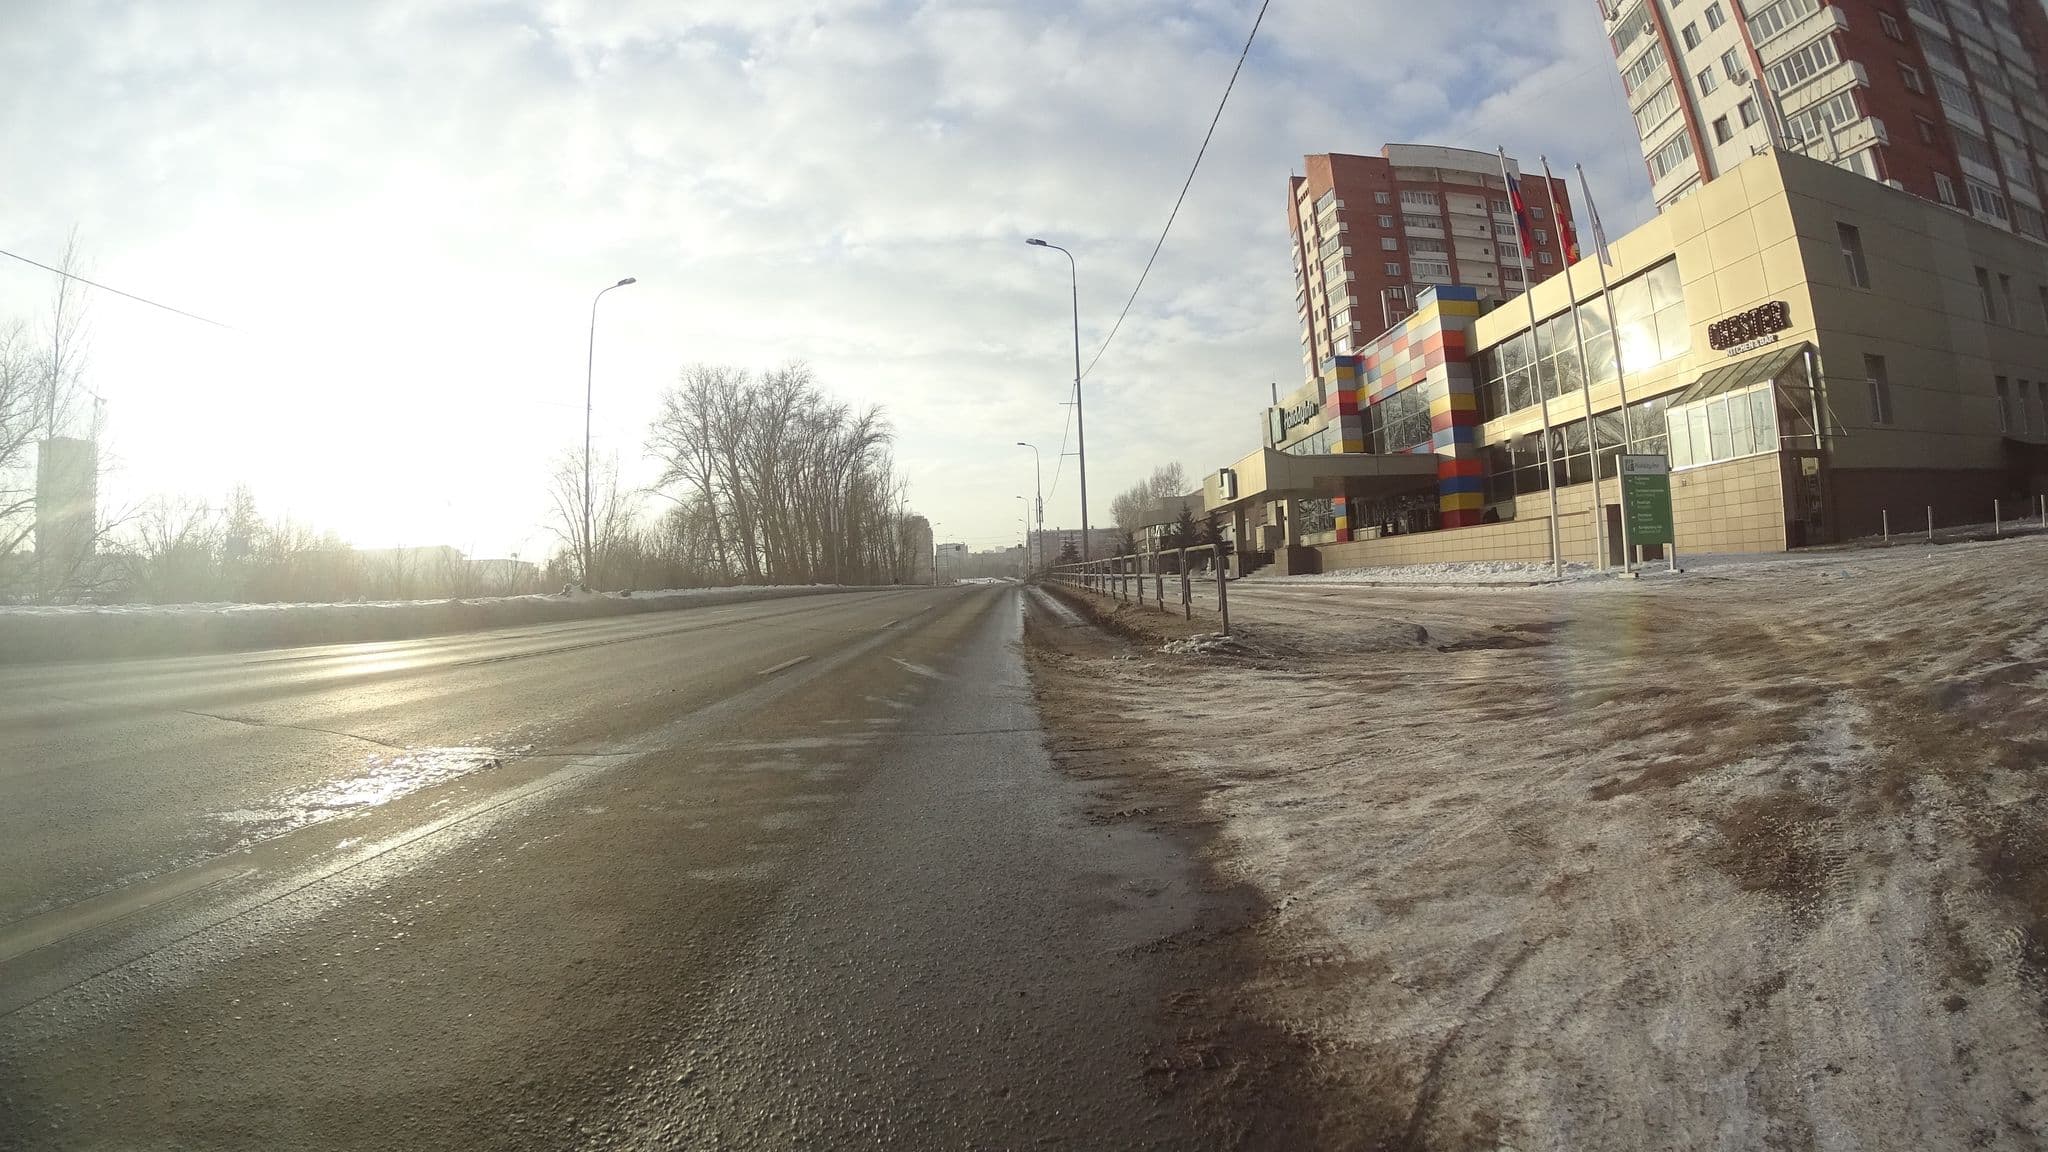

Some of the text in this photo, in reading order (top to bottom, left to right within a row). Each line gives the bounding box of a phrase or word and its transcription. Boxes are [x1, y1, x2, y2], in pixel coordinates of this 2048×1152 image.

[1708, 301, 1787, 350] CHESTER
[1727, 341, 1755, 357] KITCHEN
[1760, 335, 1775, 347] BAR
